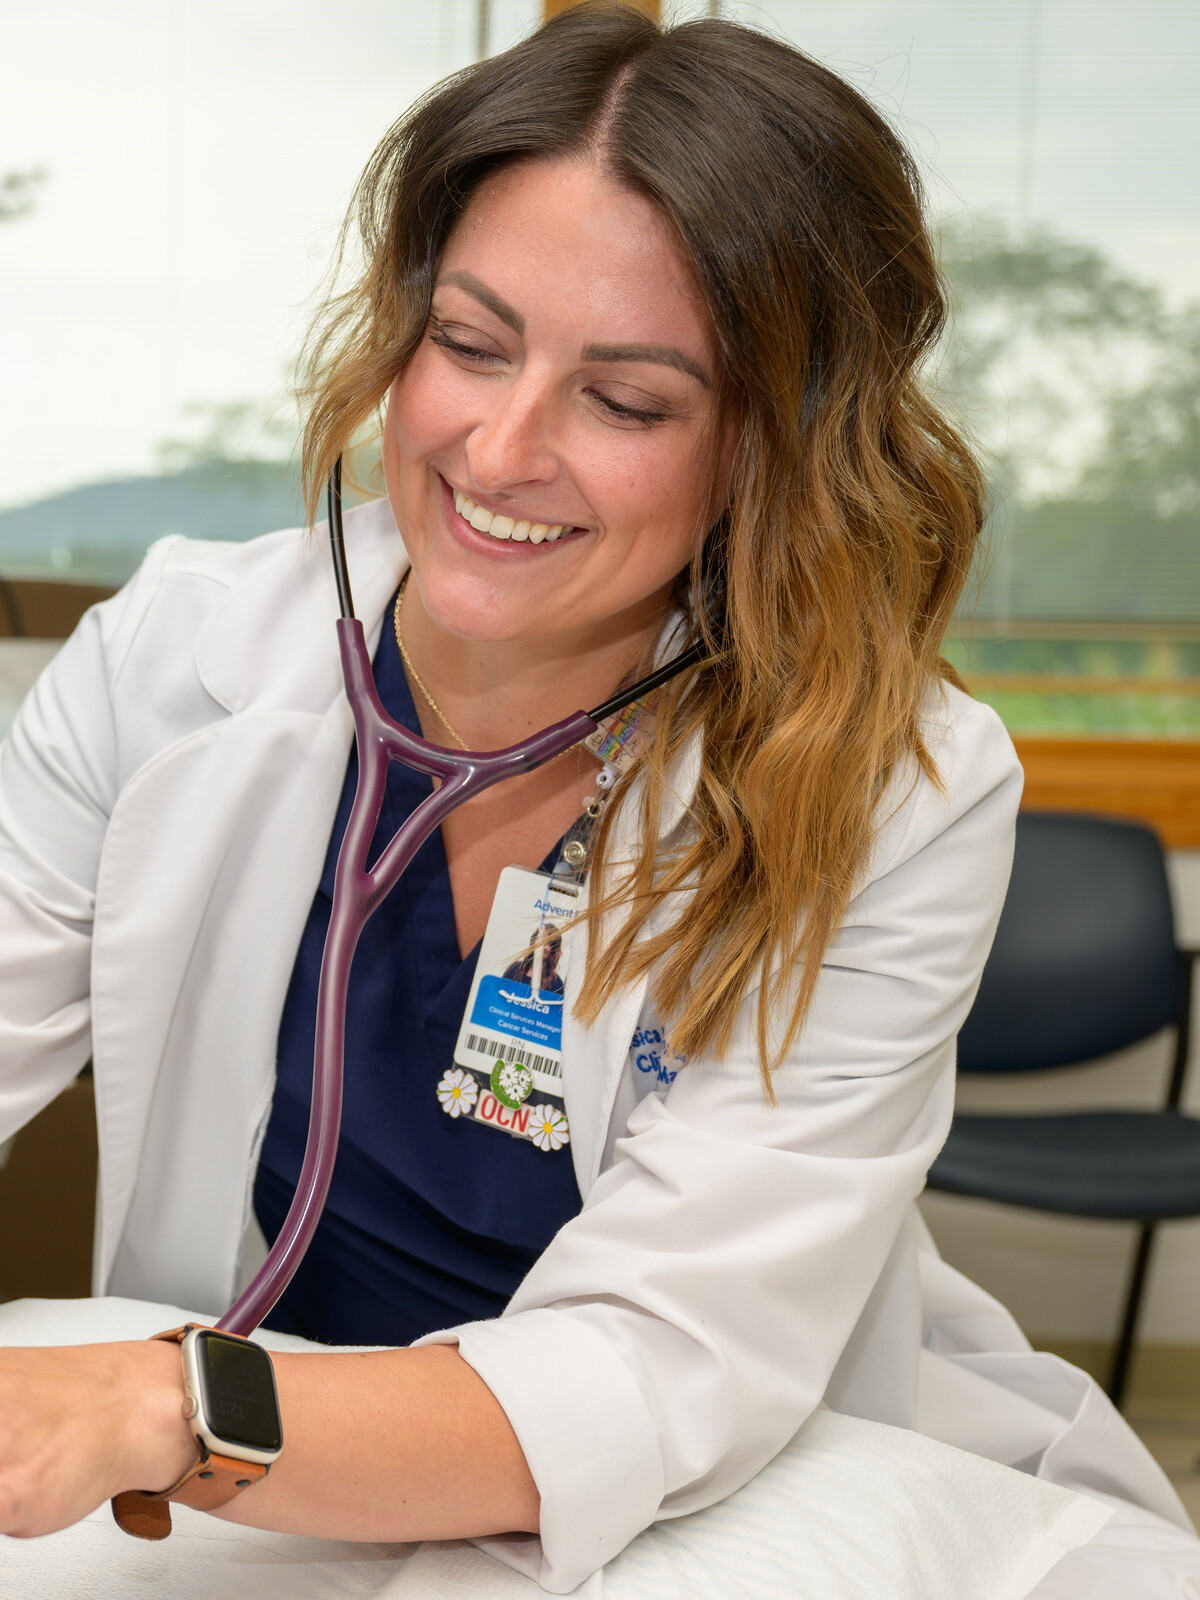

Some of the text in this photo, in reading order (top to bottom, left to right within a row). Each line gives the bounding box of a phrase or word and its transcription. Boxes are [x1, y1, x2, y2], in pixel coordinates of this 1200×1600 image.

[489, 1005, 562, 1034] Clinical Services Manager
[497, 1019, 549, 1041] Cancer Services
[510, 1038, 526, 1049] RN
[480, 1093, 531, 1134] OCN
